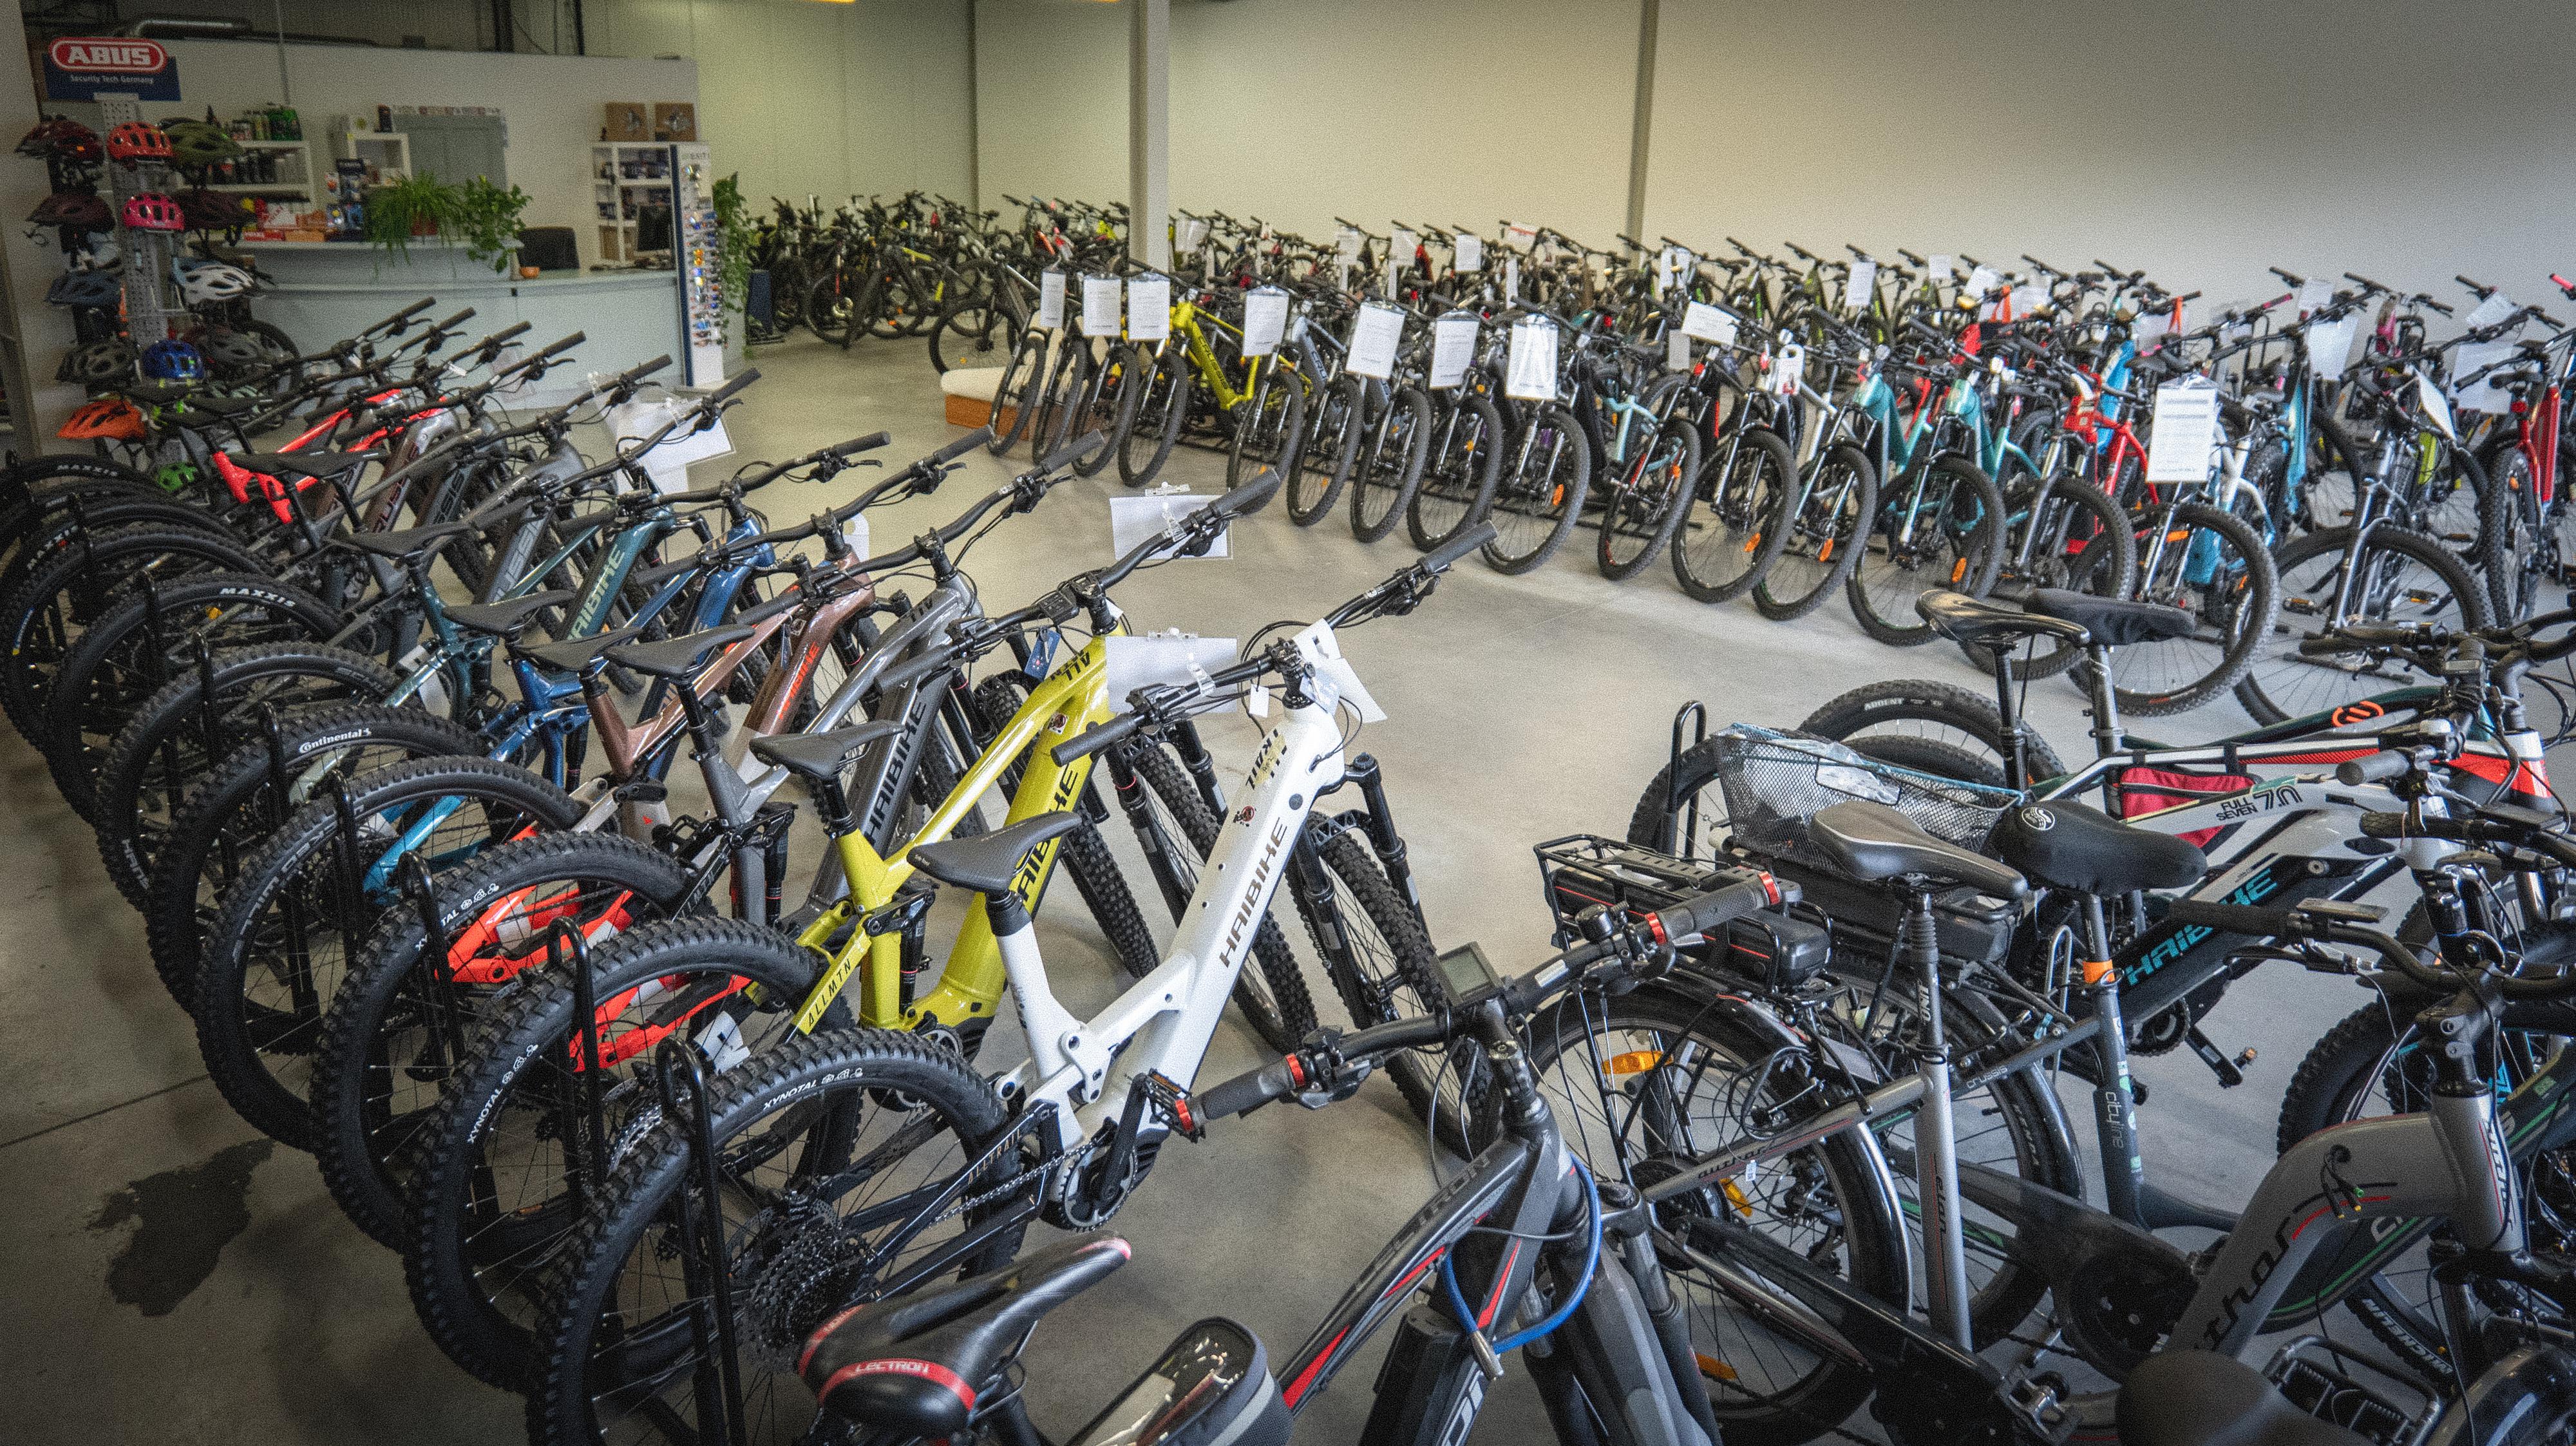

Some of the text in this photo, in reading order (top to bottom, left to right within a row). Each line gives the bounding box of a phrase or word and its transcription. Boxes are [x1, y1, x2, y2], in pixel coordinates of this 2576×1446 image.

[67, 45, 151, 66] ABUS
[70, 74, 154, 85] Security Tech Germany
[219, 587, 296, 607] MAXXIS
[567, 542, 626, 641] AIBIKE
[299, 730, 363, 754] Continental
[2216, 803, 2259, 821] SEVEN
[2220, 795, 2253, 812] FULL
[1219, 817, 1288, 970] HAIBIKE
[413, 907, 460, 952] XYTAL
[808, 957, 853, 1028] ALLMTN
[762, 1078, 818, 1112] XYNOTAL
[1965, 1064, 2008, 1089] crussis
[466, 1086, 504, 1143] XYNOTAL
[2104, 1090, 2125, 1148] cityline
[967, 1127, 1022, 1185] ALLTRAIL
[1935, 1176, 1947, 1235] elan
[2361, 1298, 2454, 1375] MICHELIN
